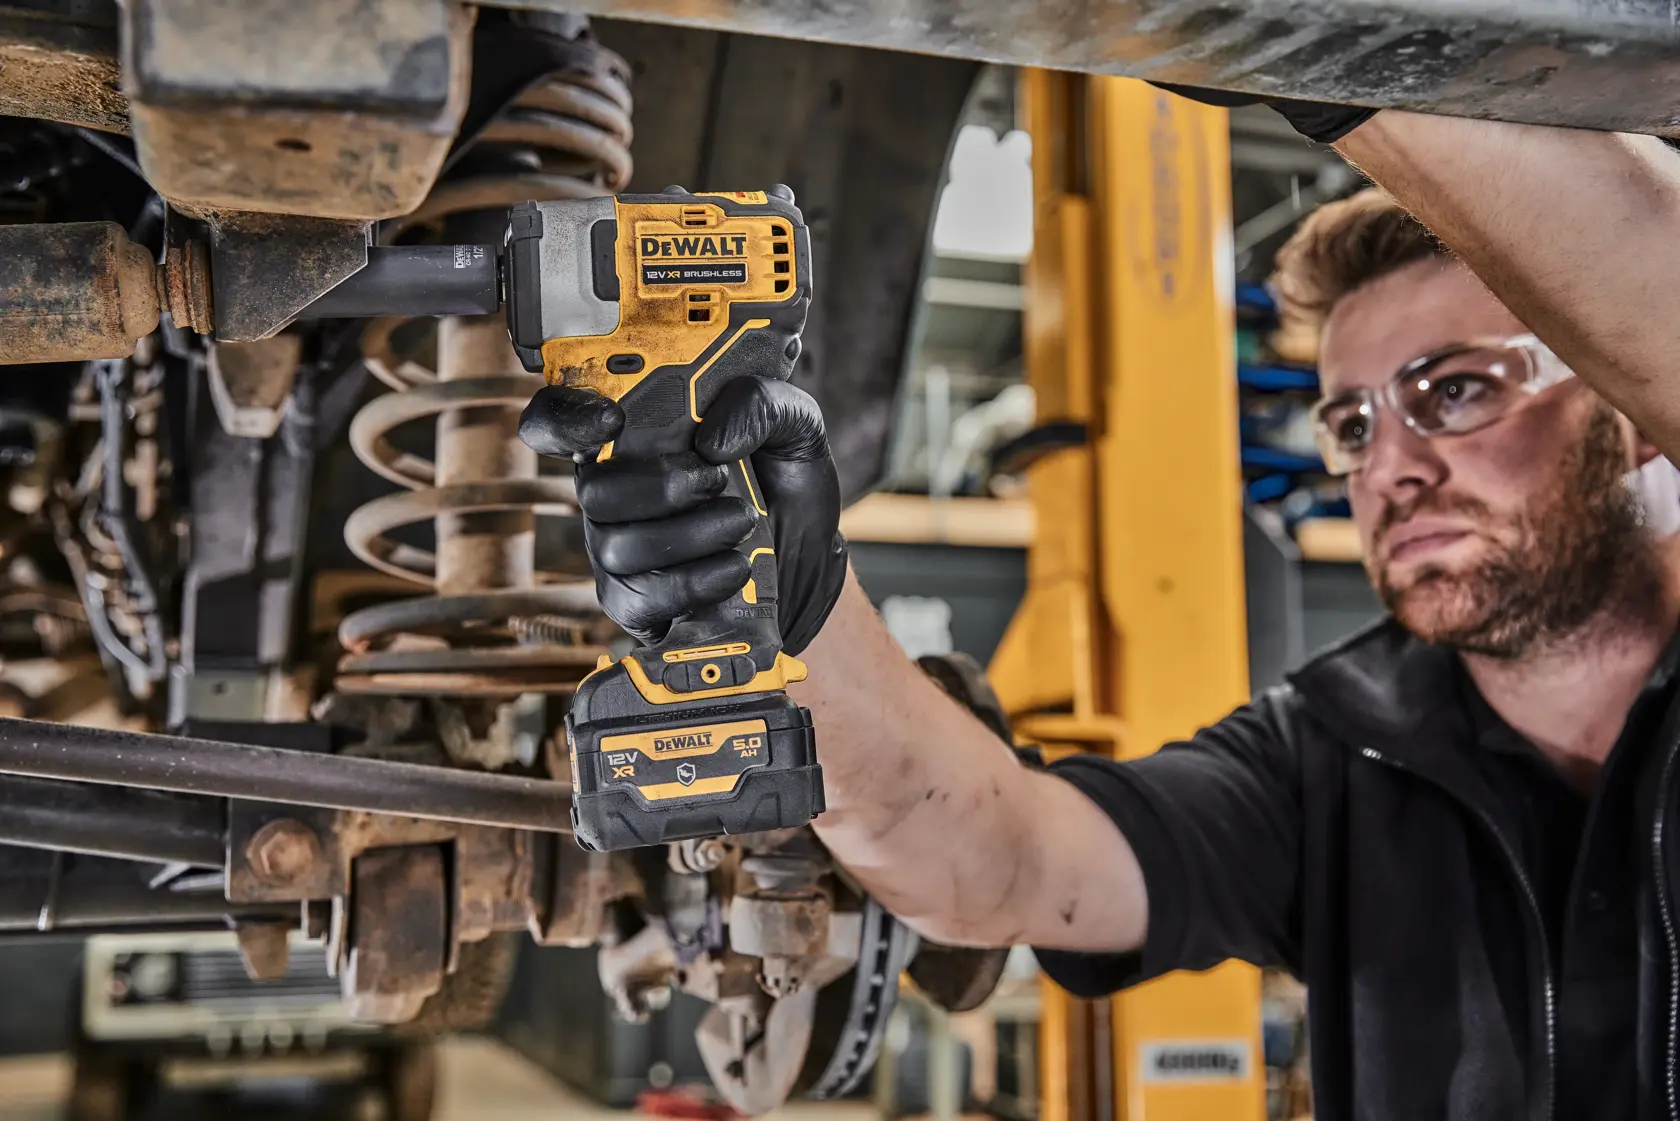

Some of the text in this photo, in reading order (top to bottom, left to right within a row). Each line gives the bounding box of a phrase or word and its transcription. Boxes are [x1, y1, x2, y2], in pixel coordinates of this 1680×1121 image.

[640, 236, 747, 257] DEWALT
[684, 270, 742, 278] BRUSHLESS
[654, 733, 712, 752] DEWALT
[732, 737, 762, 751] 5.0
[607, 751, 638, 766] 12V
[740, 750, 758, 758] AH
[612, 765, 635, 779] XR
